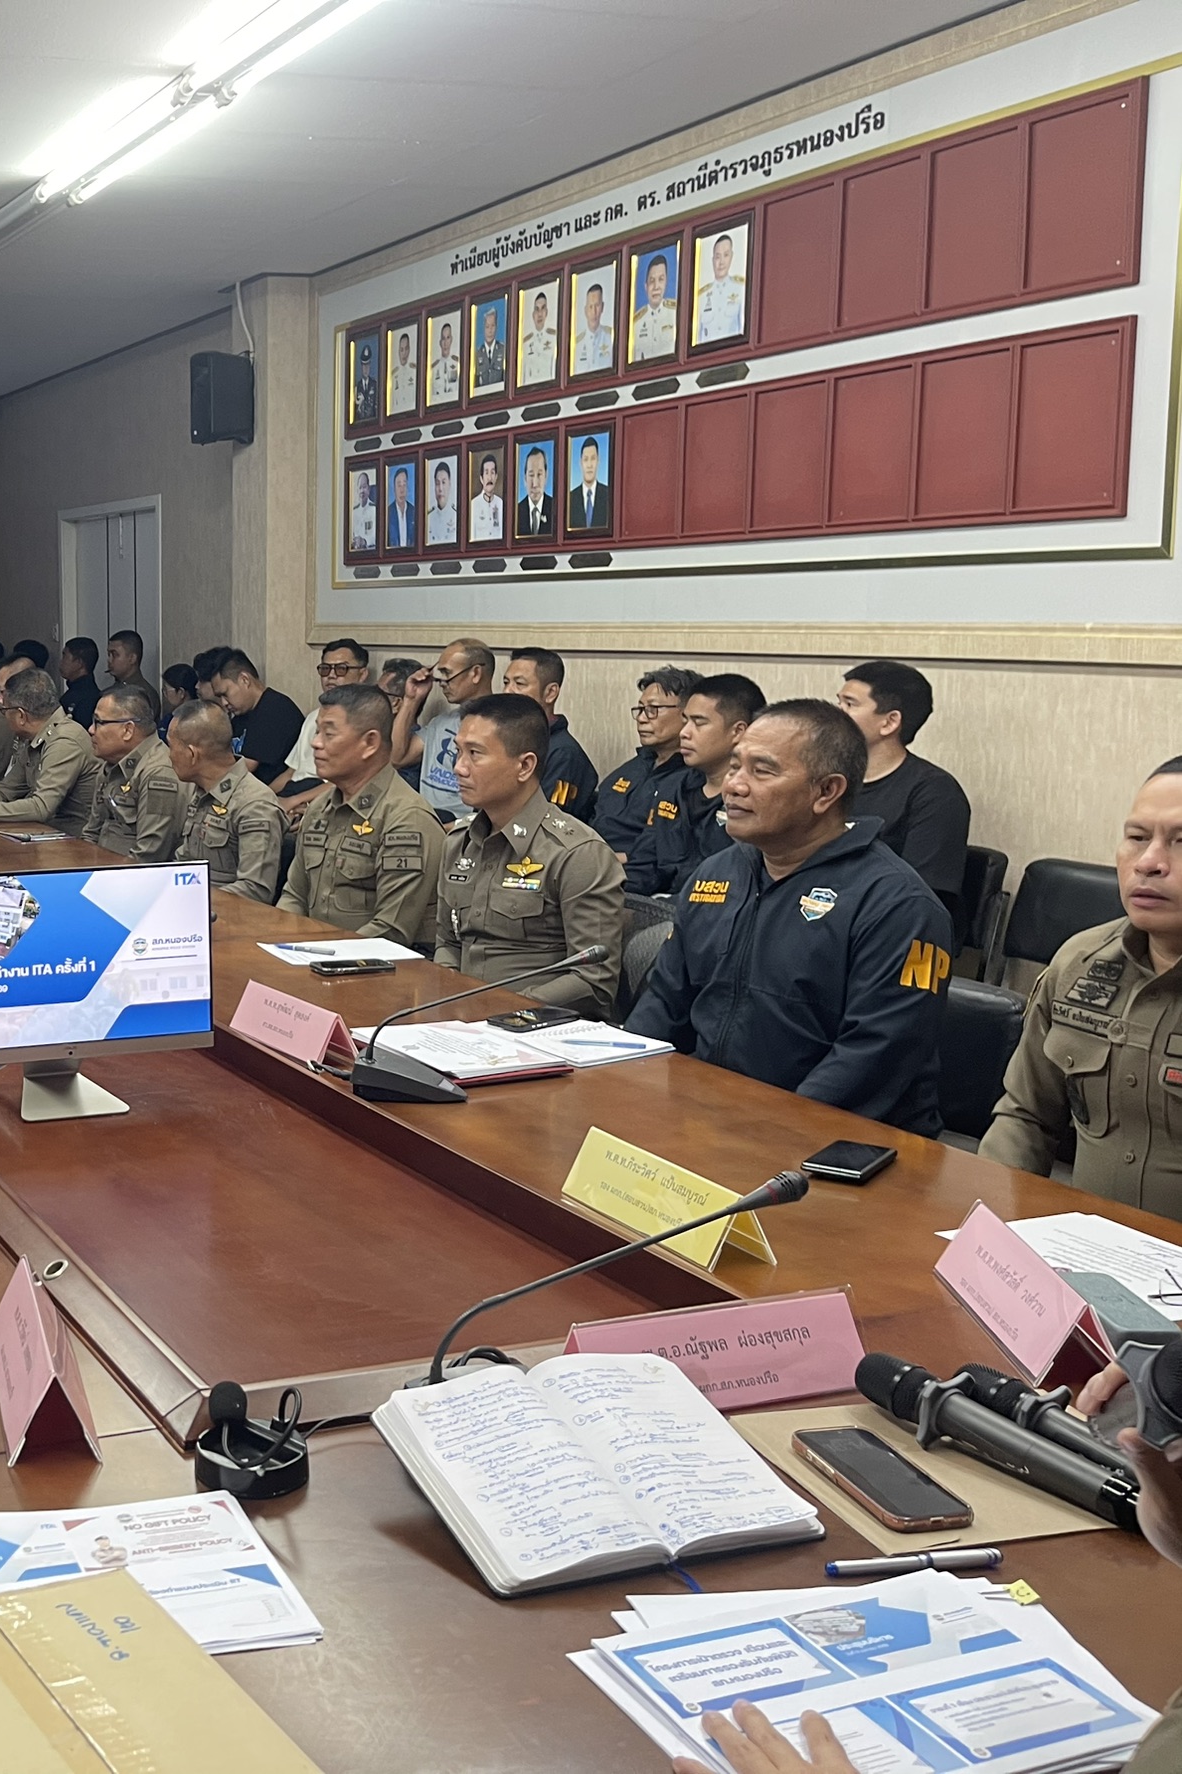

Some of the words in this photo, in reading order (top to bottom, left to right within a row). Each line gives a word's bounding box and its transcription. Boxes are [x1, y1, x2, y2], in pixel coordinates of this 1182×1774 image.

[450, 221, 570, 276] ทำเนียบผู้บังคับบัญชา
[574, 209, 601, 233] และ
[637, 190, 661, 212] ตร.
[666, 104, 886, 202] สถานีตำรวจภูธรหนองปรือ
[430, 765, 456, 781] UNDE
[397, 858, 408, 868] 21
[174, 872, 201, 886] ITA
[32, 964, 53, 976] ITA
[55, 956, 87, 975] ครั้งที่
[89, 960, 96, 972] 1
[899, 939, 951, 995] NP
[737, 1324, 811, 1349] ผ่องสุขสกุล
